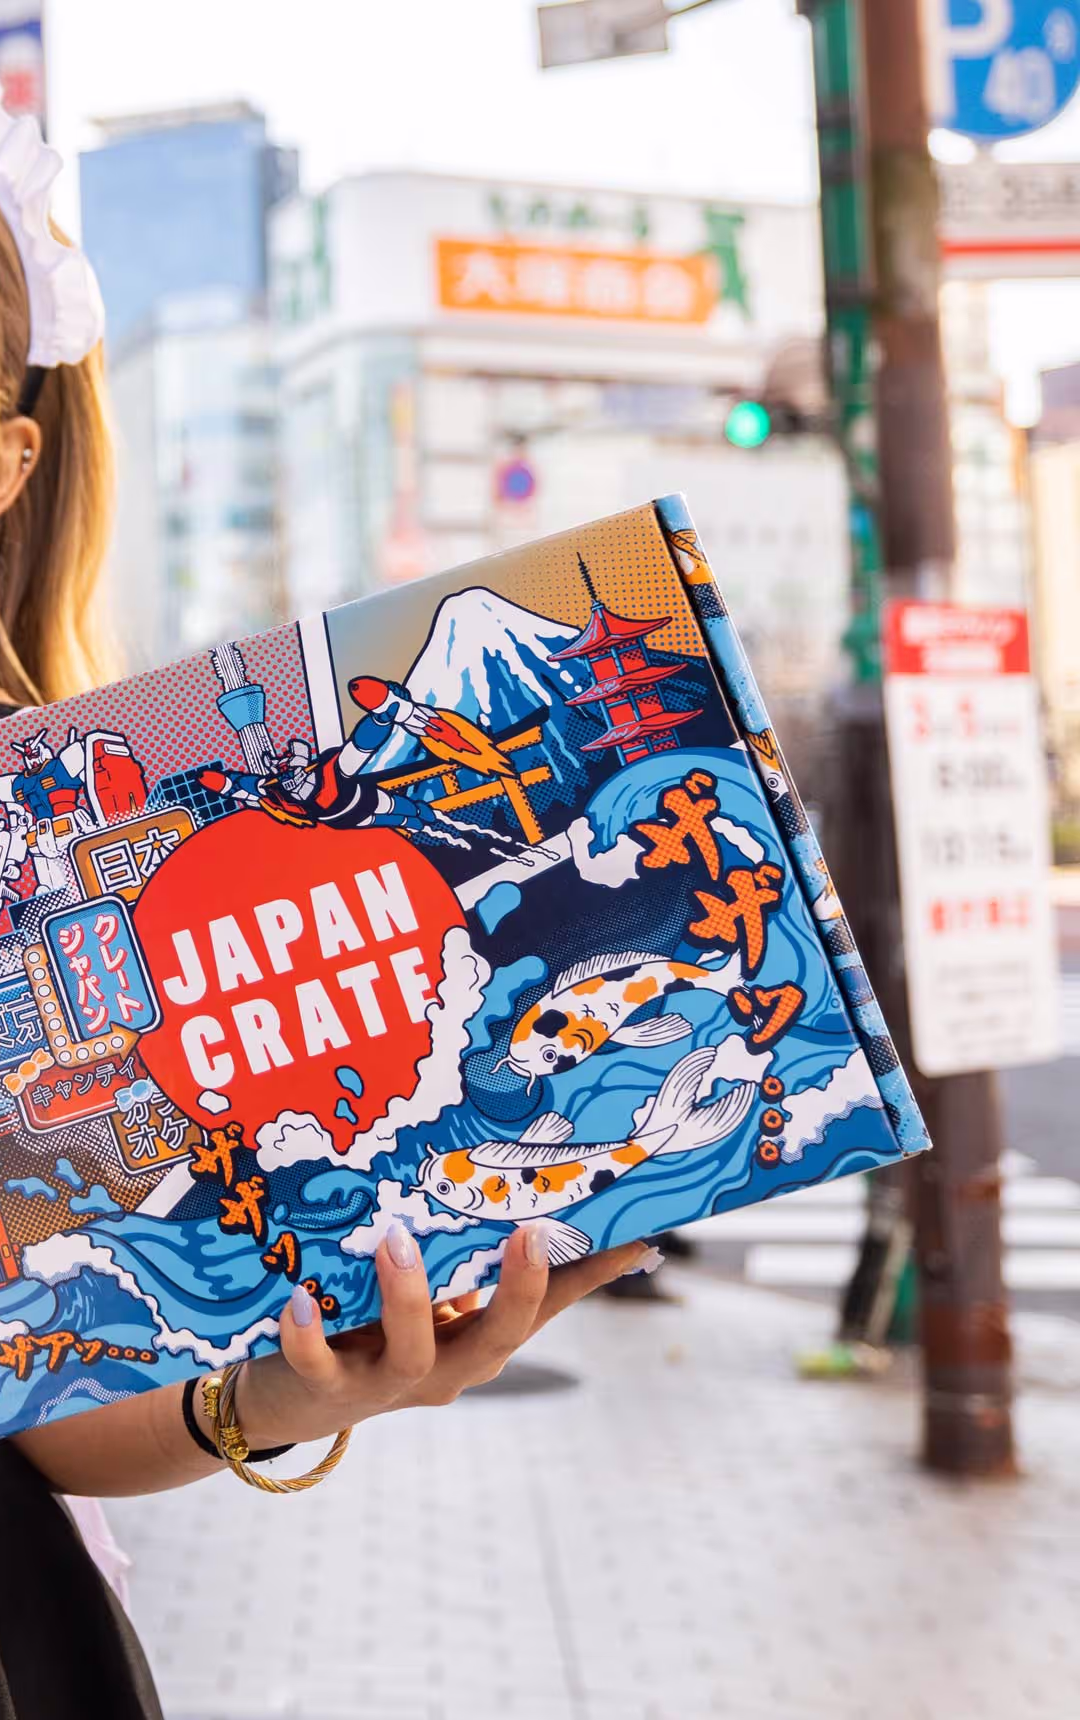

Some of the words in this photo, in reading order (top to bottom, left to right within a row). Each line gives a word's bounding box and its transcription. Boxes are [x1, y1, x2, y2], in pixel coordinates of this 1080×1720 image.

[90, 827, 180, 893] 日本
[58, 922, 107, 1034] ジャパン
[93, 913, 144, 1022] クレート
[163, 862, 419, 1005] JAPAN
[181, 947, 438, 1088] CRATE
[32, 1056, 136, 1107] キャンディ
